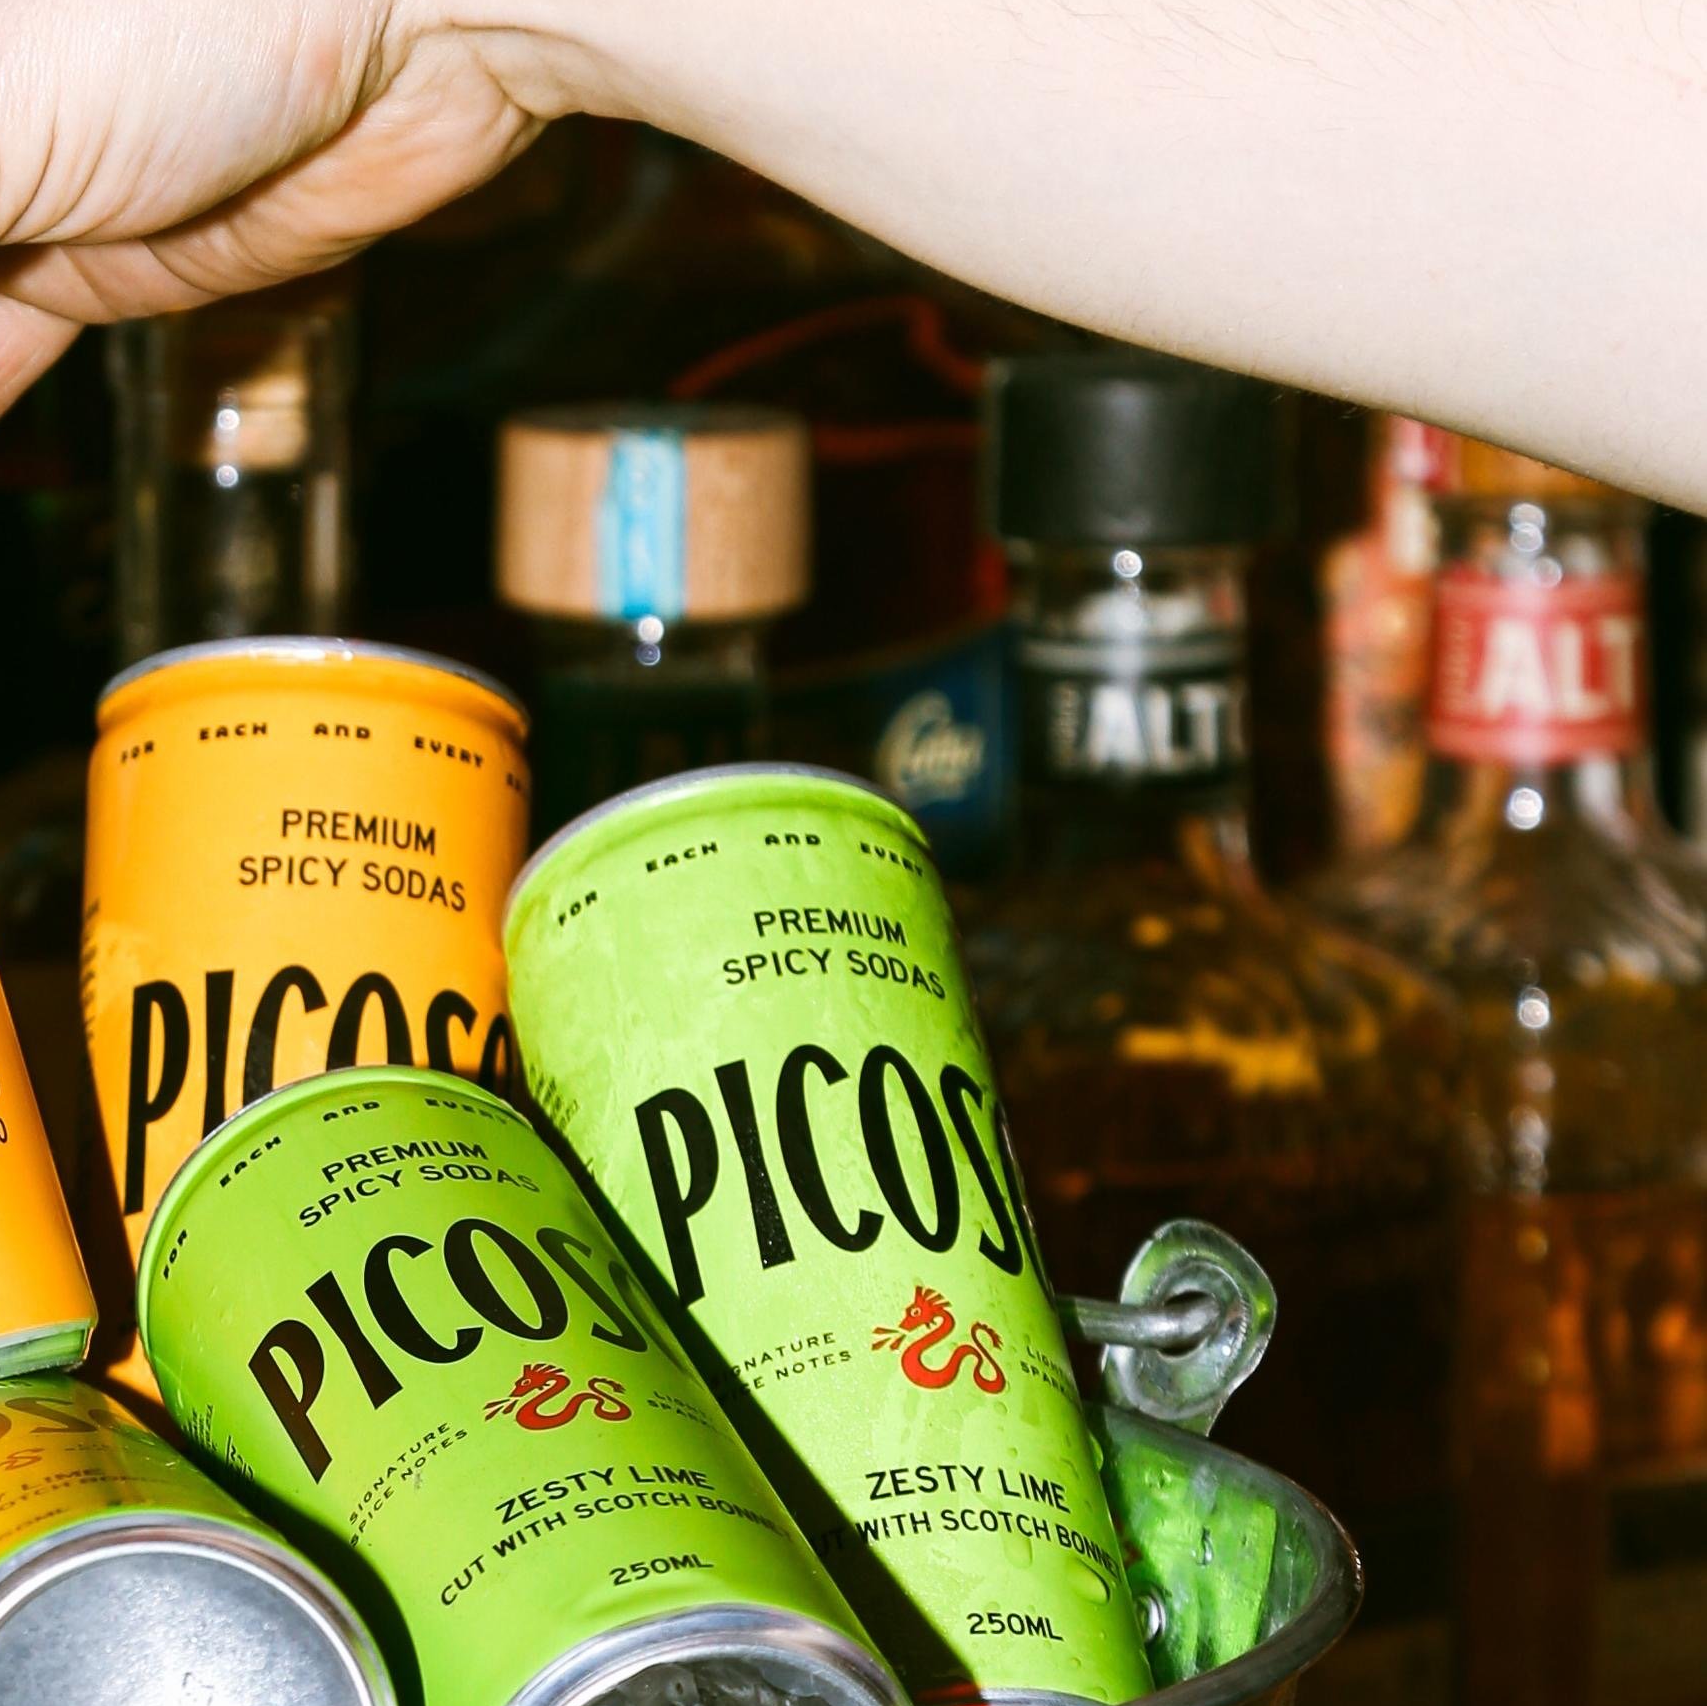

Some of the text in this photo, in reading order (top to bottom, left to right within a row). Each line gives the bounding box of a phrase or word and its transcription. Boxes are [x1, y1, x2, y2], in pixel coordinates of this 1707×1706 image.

[120, 722, 485, 770] FOR EACH AND EVERY
[281, 809, 437, 856] PREMIUM
[239, 856, 467, 913] SPICY SODAS
[557, 833, 924, 927] FOR EACH AND EVERY
[753, 908, 908, 948] PREMIUM
[722, 948, 946, 1001] SPICY SODAS
[321, 1139, 489, 1184] PREMIUM
[634, 1043, 1043, 1311] PICOS
[163, 1229, 188, 1280] FOR
[219, 1136, 282, 1188] EACH
[323, 1101, 381, 1122] AND
[425, 1098, 511, 1126] EVERY
[298, 1163, 541, 1229] SPICY SODAS
[775, 1349, 852, 1381] NOTES
[349, 1422, 452, 1527] SIGNATURE
[350, 1427, 469, 1548] SPICE NOTES
[495, 1465, 716, 1525] ZESTY LIME
[865, 1464, 1072, 1514] ZESTY LIME
[441, 1557, 487, 1607] CUT
[491, 1512, 566, 1560] WITH
[578, 1492, 689, 1521] SCOTCH
[855, 1510, 932, 1545] WITH
[941, 1509, 1050, 1542] SCOTCH
[609, 1552, 712, 1588] 250ML
[966, 1612, 1065, 1642] 250ML
